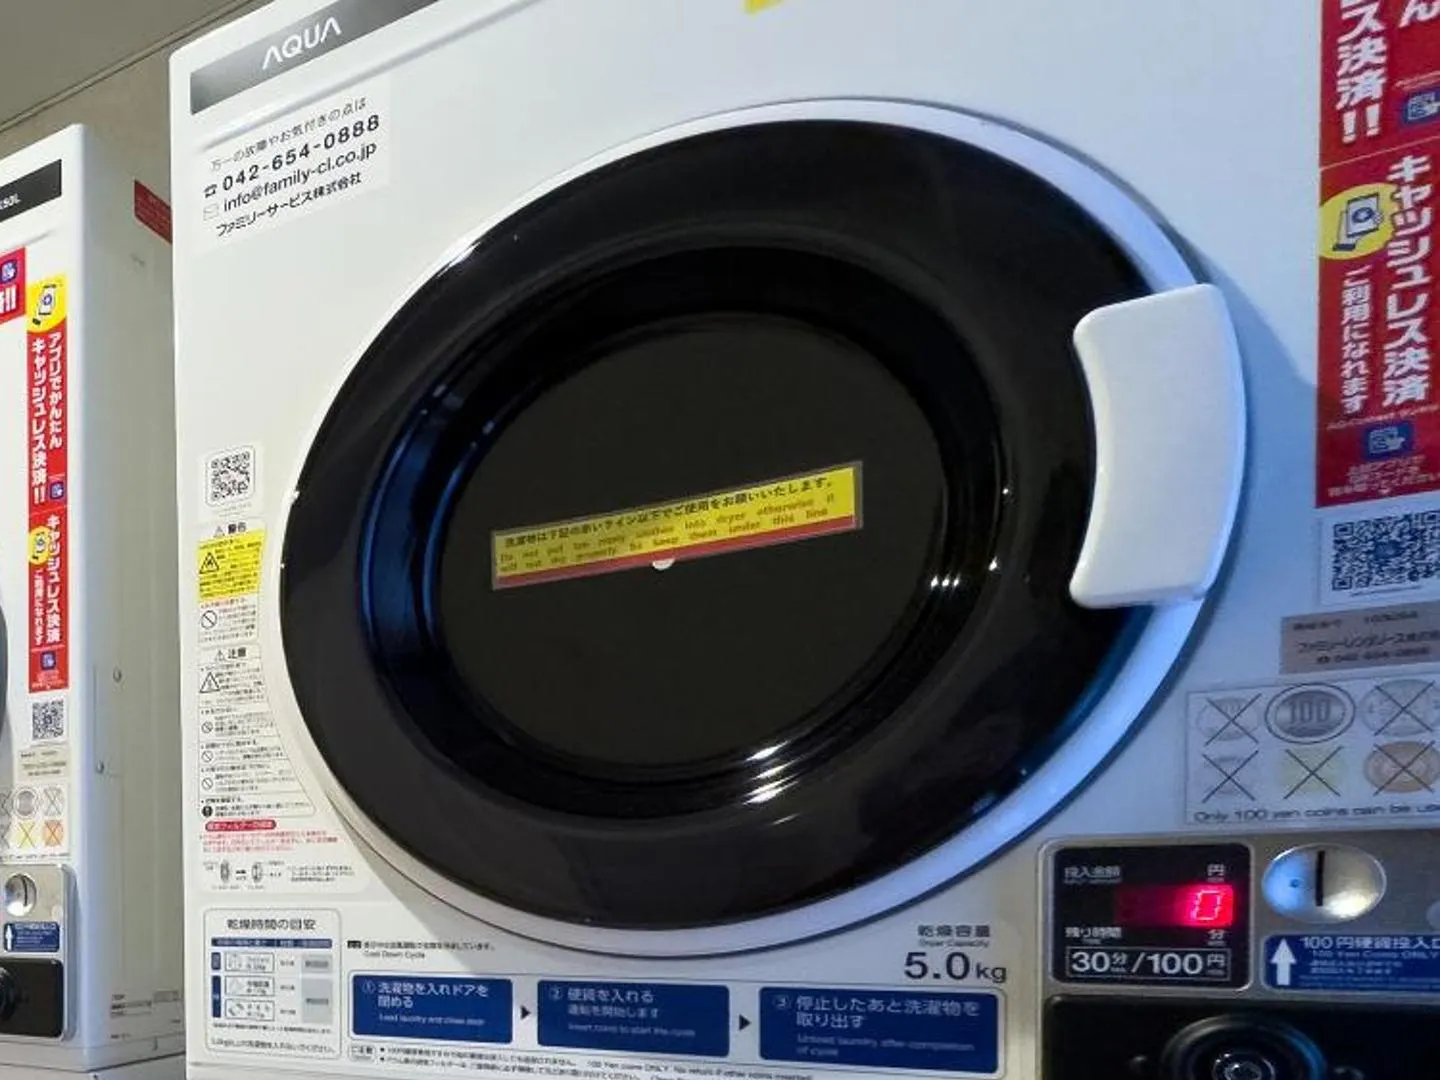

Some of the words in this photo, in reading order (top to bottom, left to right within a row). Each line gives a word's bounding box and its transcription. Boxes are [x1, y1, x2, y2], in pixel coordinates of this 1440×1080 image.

[262, 17, 342, 70] AQUA
[1336, 0, 1387, 143] ス決済!!
[222, 114, 380, 191] 042-654-0888
[224, 142, 378, 212] info@family-cl.co.jp
[216, 171, 362, 237] ファミリーサービス株式会社
[1382, 154, 1433, 408] キャッシュレス決済
[1194, 809, 1229, 824] Only
[1235, 808, 1268, 821] 100
[1191, 889, 1225, 921] 0
